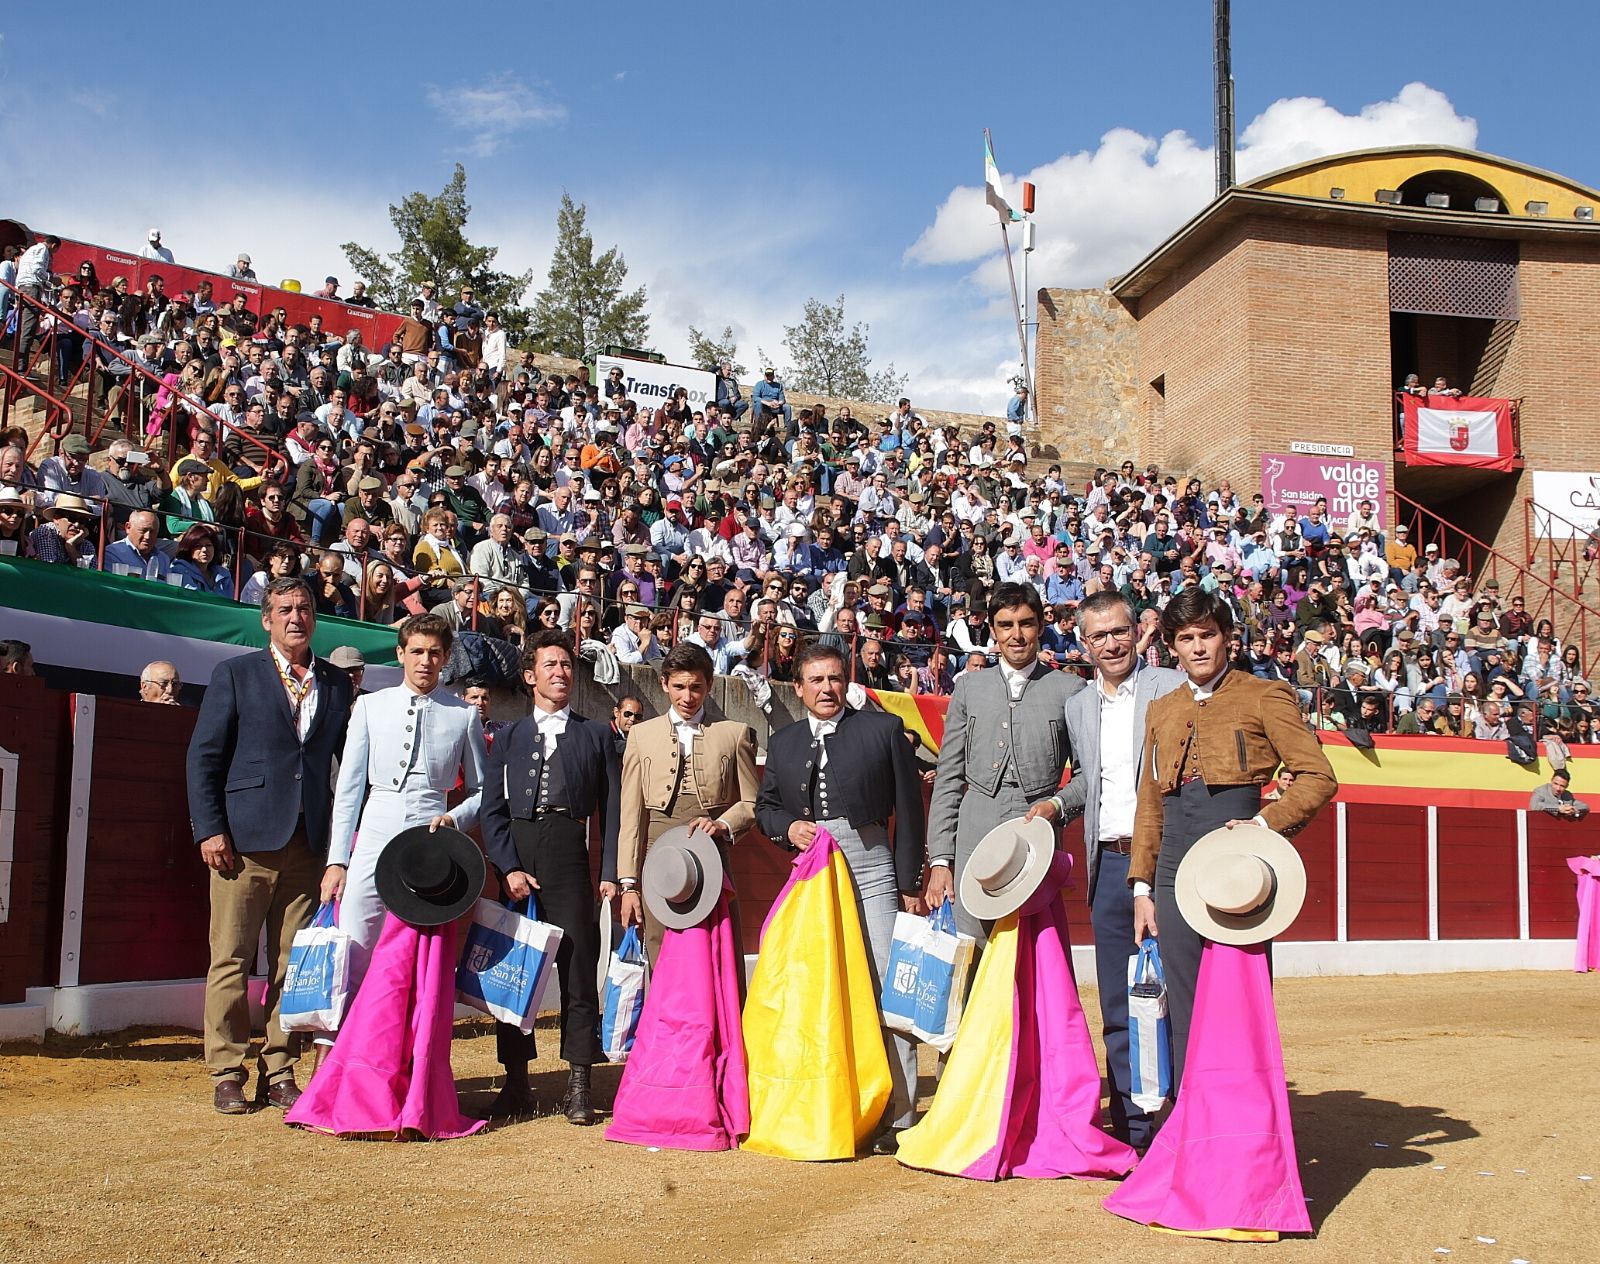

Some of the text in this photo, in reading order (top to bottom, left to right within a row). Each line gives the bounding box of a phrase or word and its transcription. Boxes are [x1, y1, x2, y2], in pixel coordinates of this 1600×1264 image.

[627, 377, 708, 403] Transfox
[1294, 443, 1351, 454] PRESIDENCIA
[1320, 462, 1379, 483] valde
[1281, 489, 1298, 499] San
[1337, 481, 1379, 502] que
[1570, 490, 1600, 507] CA
[491, 965, 509, 980] San
